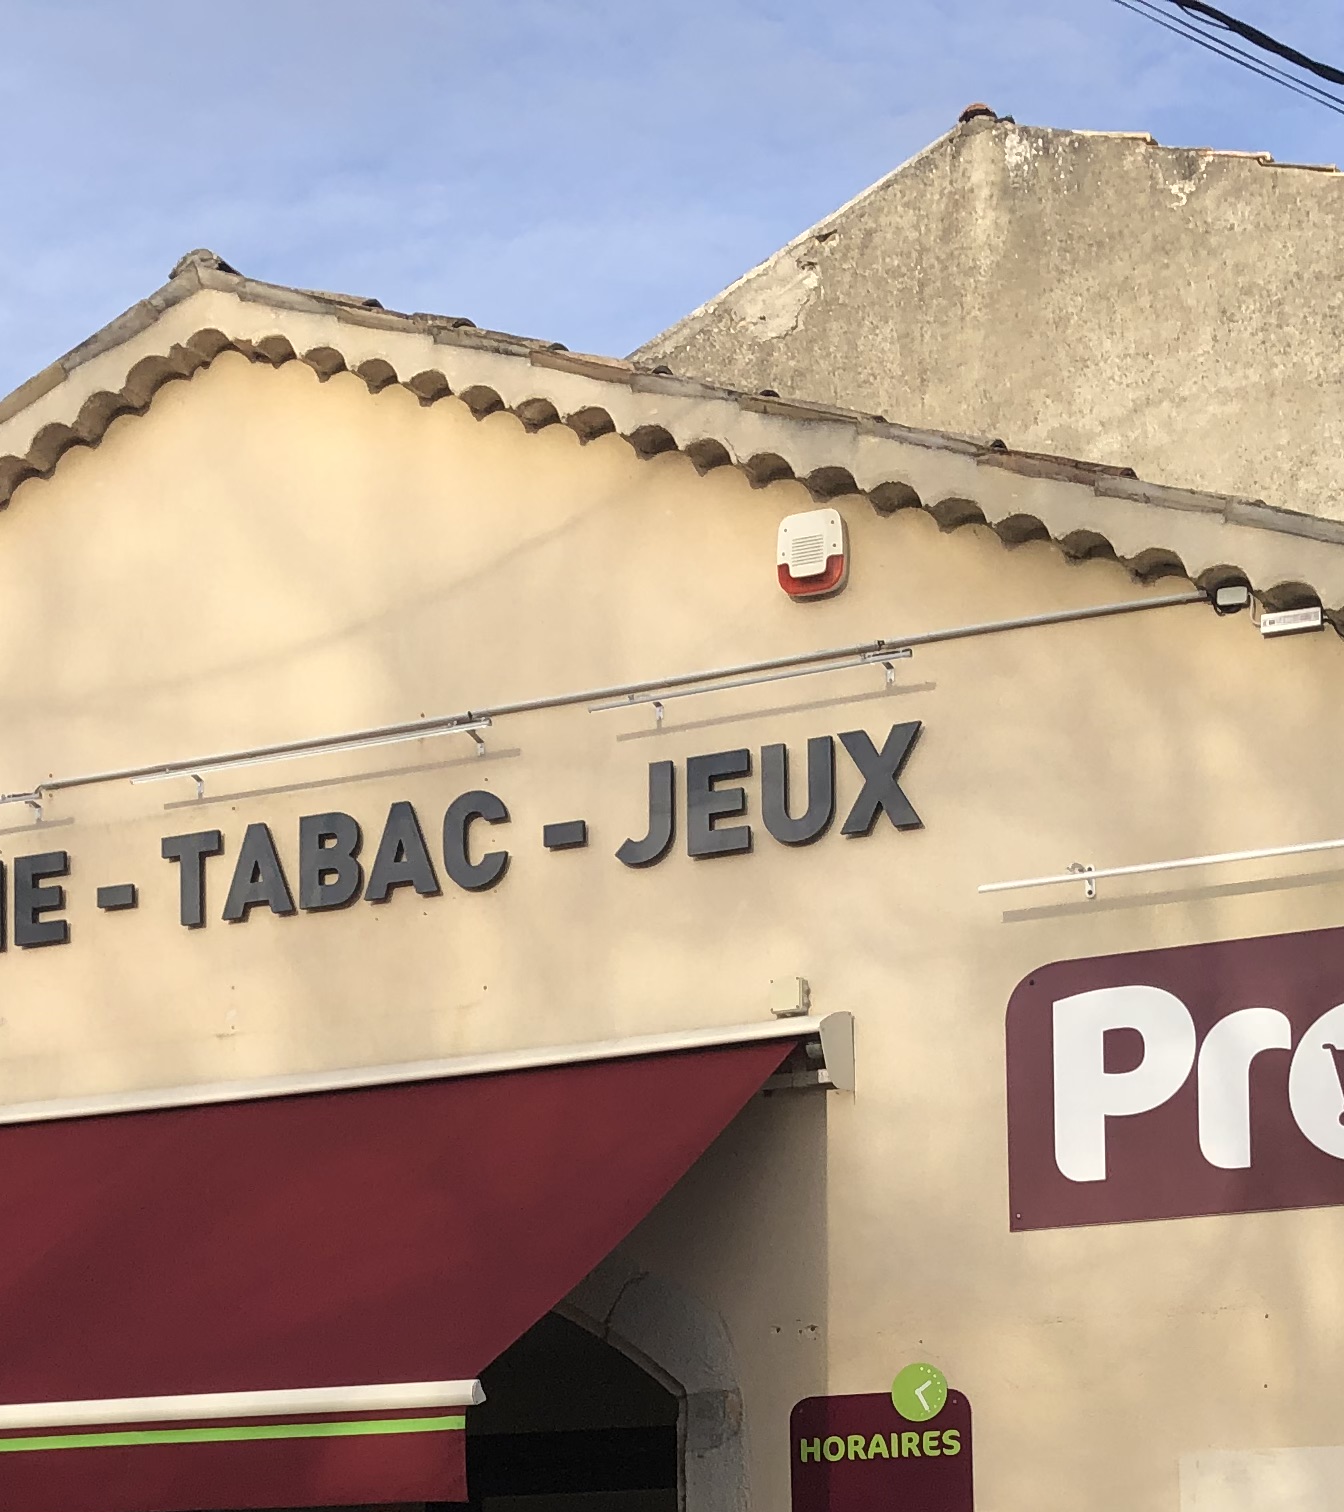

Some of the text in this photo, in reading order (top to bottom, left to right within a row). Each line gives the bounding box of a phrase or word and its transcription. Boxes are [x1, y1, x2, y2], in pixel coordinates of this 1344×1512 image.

[98, 882, 138, 911] -
[162, 789, 511, 928] TABAC
[543, 819, 588, 850] -
[613, 720, 927, 868] JEUX
[800, 1429, 961, 1463] HORAIRES
